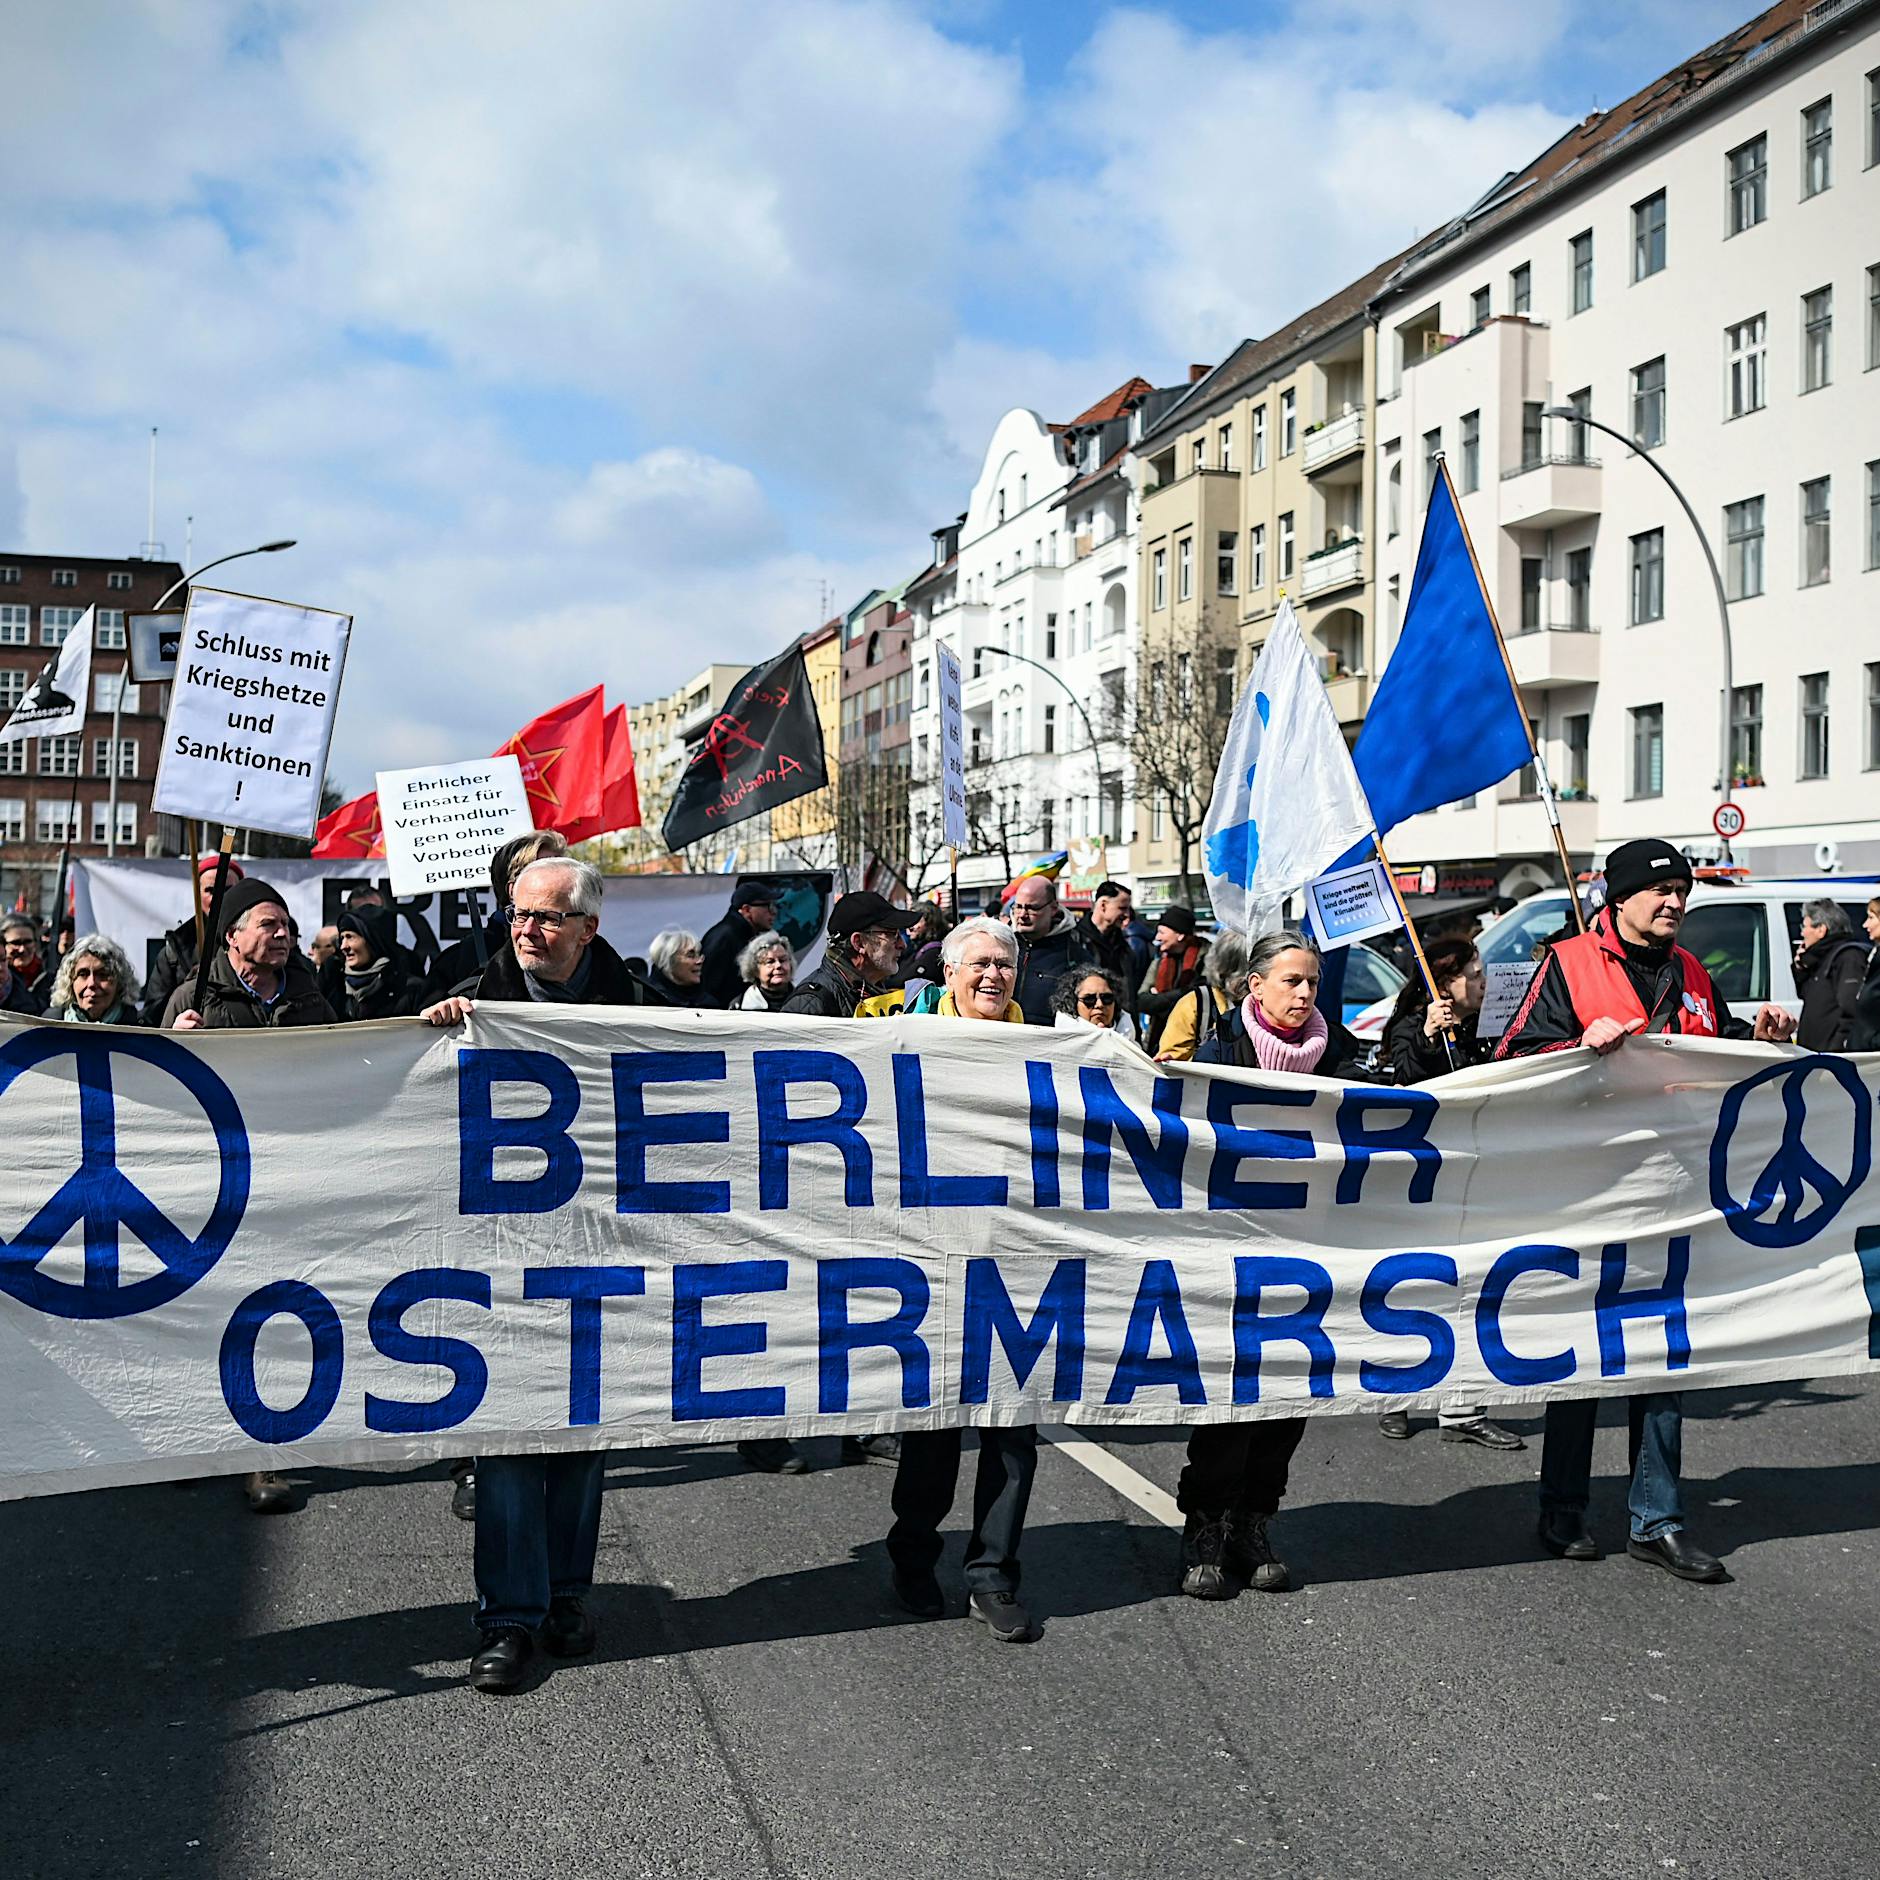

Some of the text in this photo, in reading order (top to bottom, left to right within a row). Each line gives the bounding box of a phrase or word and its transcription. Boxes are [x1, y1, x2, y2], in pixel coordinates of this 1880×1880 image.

[194, 629, 332, 672] Schluss mit
[186, 664, 327, 708] Kriegshetze
[227, 711, 275, 735] und
[175, 735, 312, 778] Sanktionen
[234, 780, 243, 802] !
[407, 774, 492, 793] Ehrlicher
[402, 789, 503, 811] Einsatz für
[394, 807, 518, 829] Verhandlun-
[1719, 812, 1739, 829] 30
[413, 826, 506, 848] gen ohne
[425, 866, 492, 884] gunge
[1322, 881, 1370, 901] Kriege weltweit
[1324, 890, 1373, 910] sind die größten
[1333, 901, 1369, 917] Klimakiller!
[458, 1048, 1443, 1215] BERLINER
[218, 1235, 1691, 1444] OSTERMARSCH
